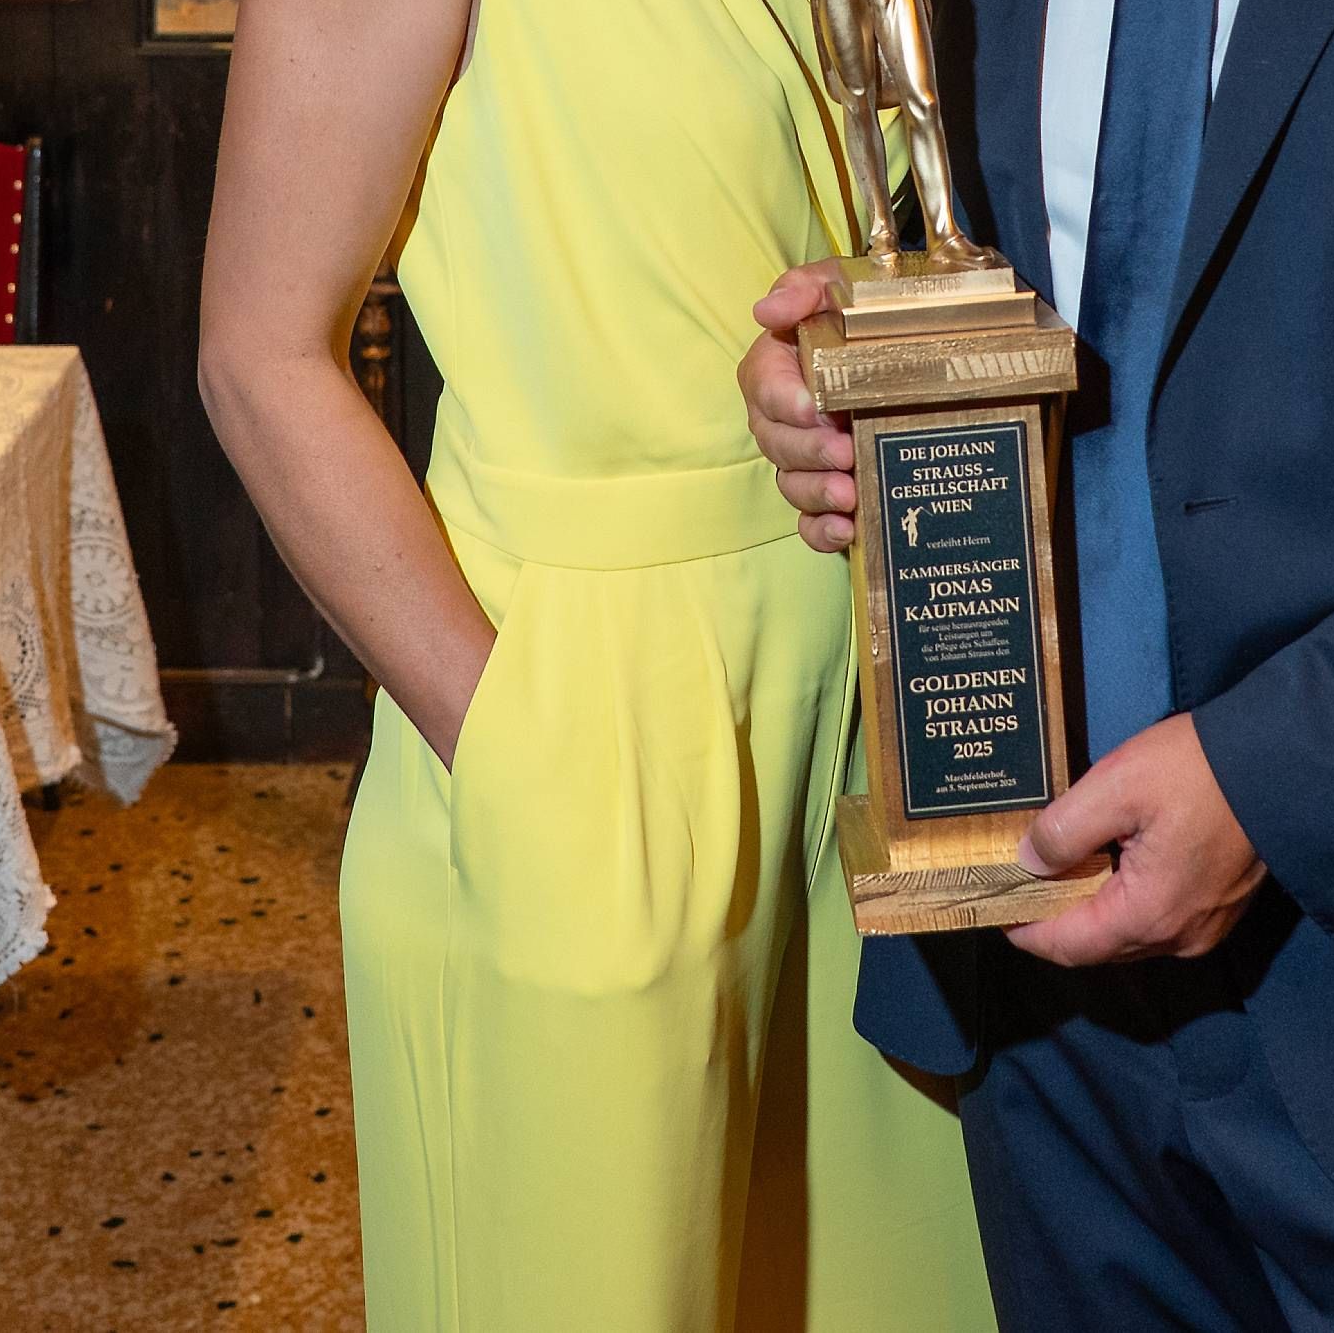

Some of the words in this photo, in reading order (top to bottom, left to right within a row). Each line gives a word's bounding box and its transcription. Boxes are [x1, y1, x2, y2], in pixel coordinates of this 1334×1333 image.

[899, 447, 927, 462] DIE
[929, 440, 996, 462] JOHANN
[912, 463, 983, 481] STRAUSS
[891, 476, 1009, 499] GESELLSCHAFT
[931, 498, 972, 514] WIEN
[926, 537, 961, 549] verleiht
[963, 535, 991, 546] Herrn
[898, 558, 1021, 580] KAMMERSÄNGER
[928, 577, 993, 601] JONAS
[904, 596, 1020, 622] KAUFMANN
[938, 631, 979, 641] Leistungen
[940, 652, 966, 661] Johann
[967, 649, 994, 658] Strauss
[996, 648, 1010, 656] den
[909, 667, 1026, 693] GOLDENEN
[925, 692, 1014, 719] JOHANN
[925, 715, 1019, 738] STRAUSS
[953, 741, 993, 759] 2025
[957, 780, 998, 792] September
[999, 778, 1017, 787] 2025
